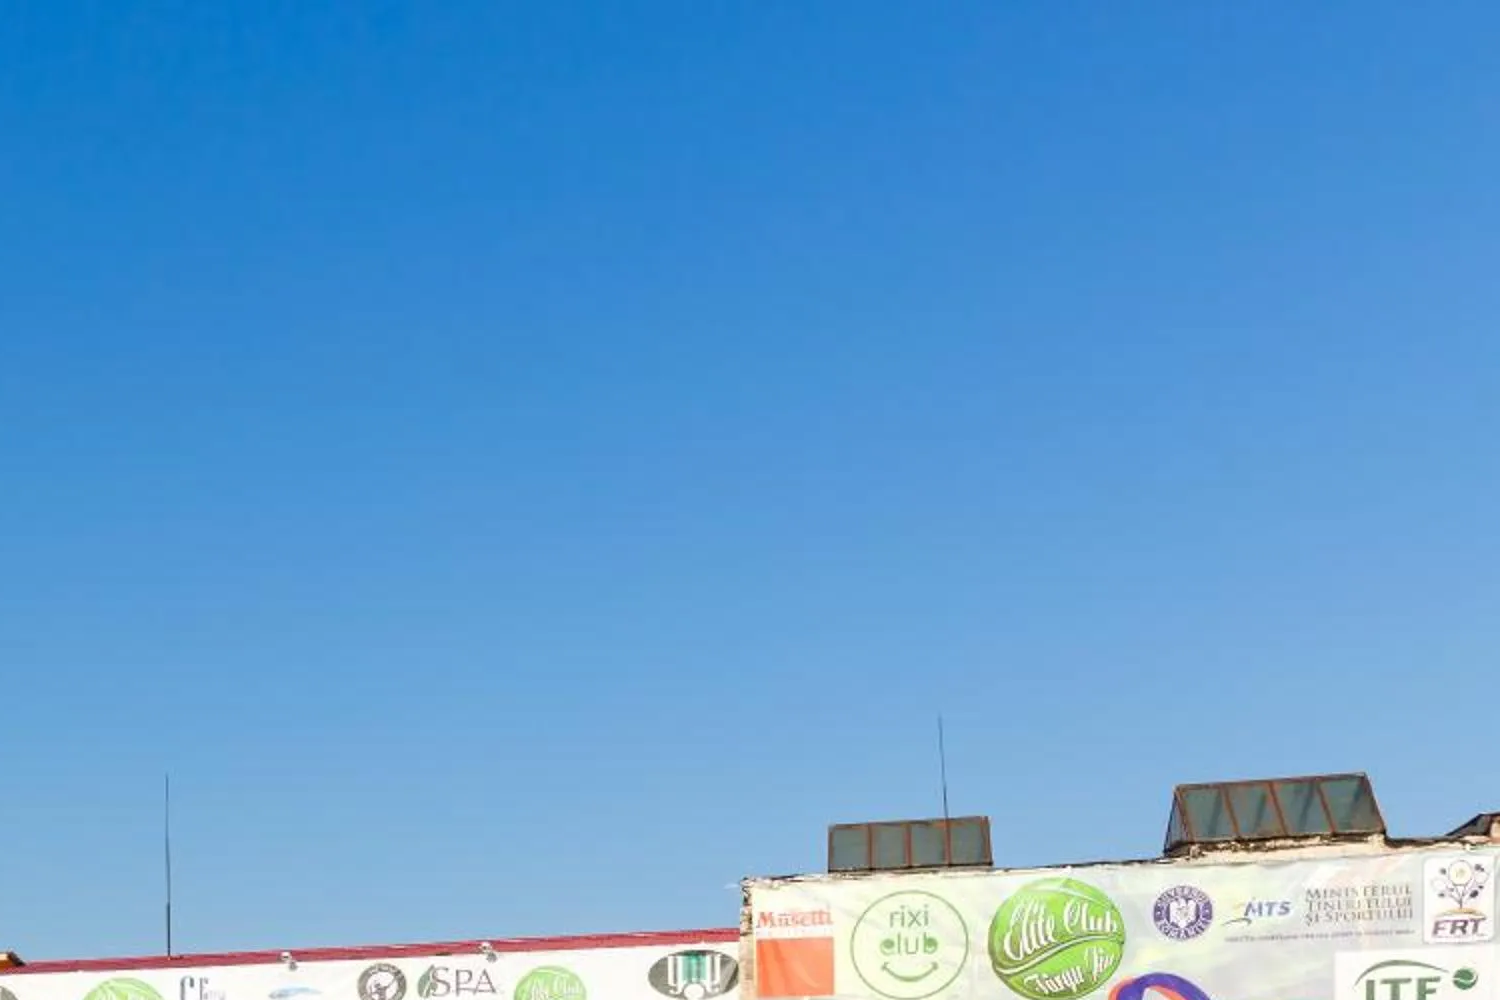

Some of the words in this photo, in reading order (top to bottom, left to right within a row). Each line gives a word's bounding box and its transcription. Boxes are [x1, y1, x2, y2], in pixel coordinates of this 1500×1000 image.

[756, 906, 835, 929] Musetti
[889, 903, 930, 928] rixi
[1063, 897, 1117, 934] Club
[1243, 898, 1292, 919] MTS
[1431, 918, 1485, 937] FRT
[879, 932, 939, 957] club
[430, 966, 496, 997] SPA
